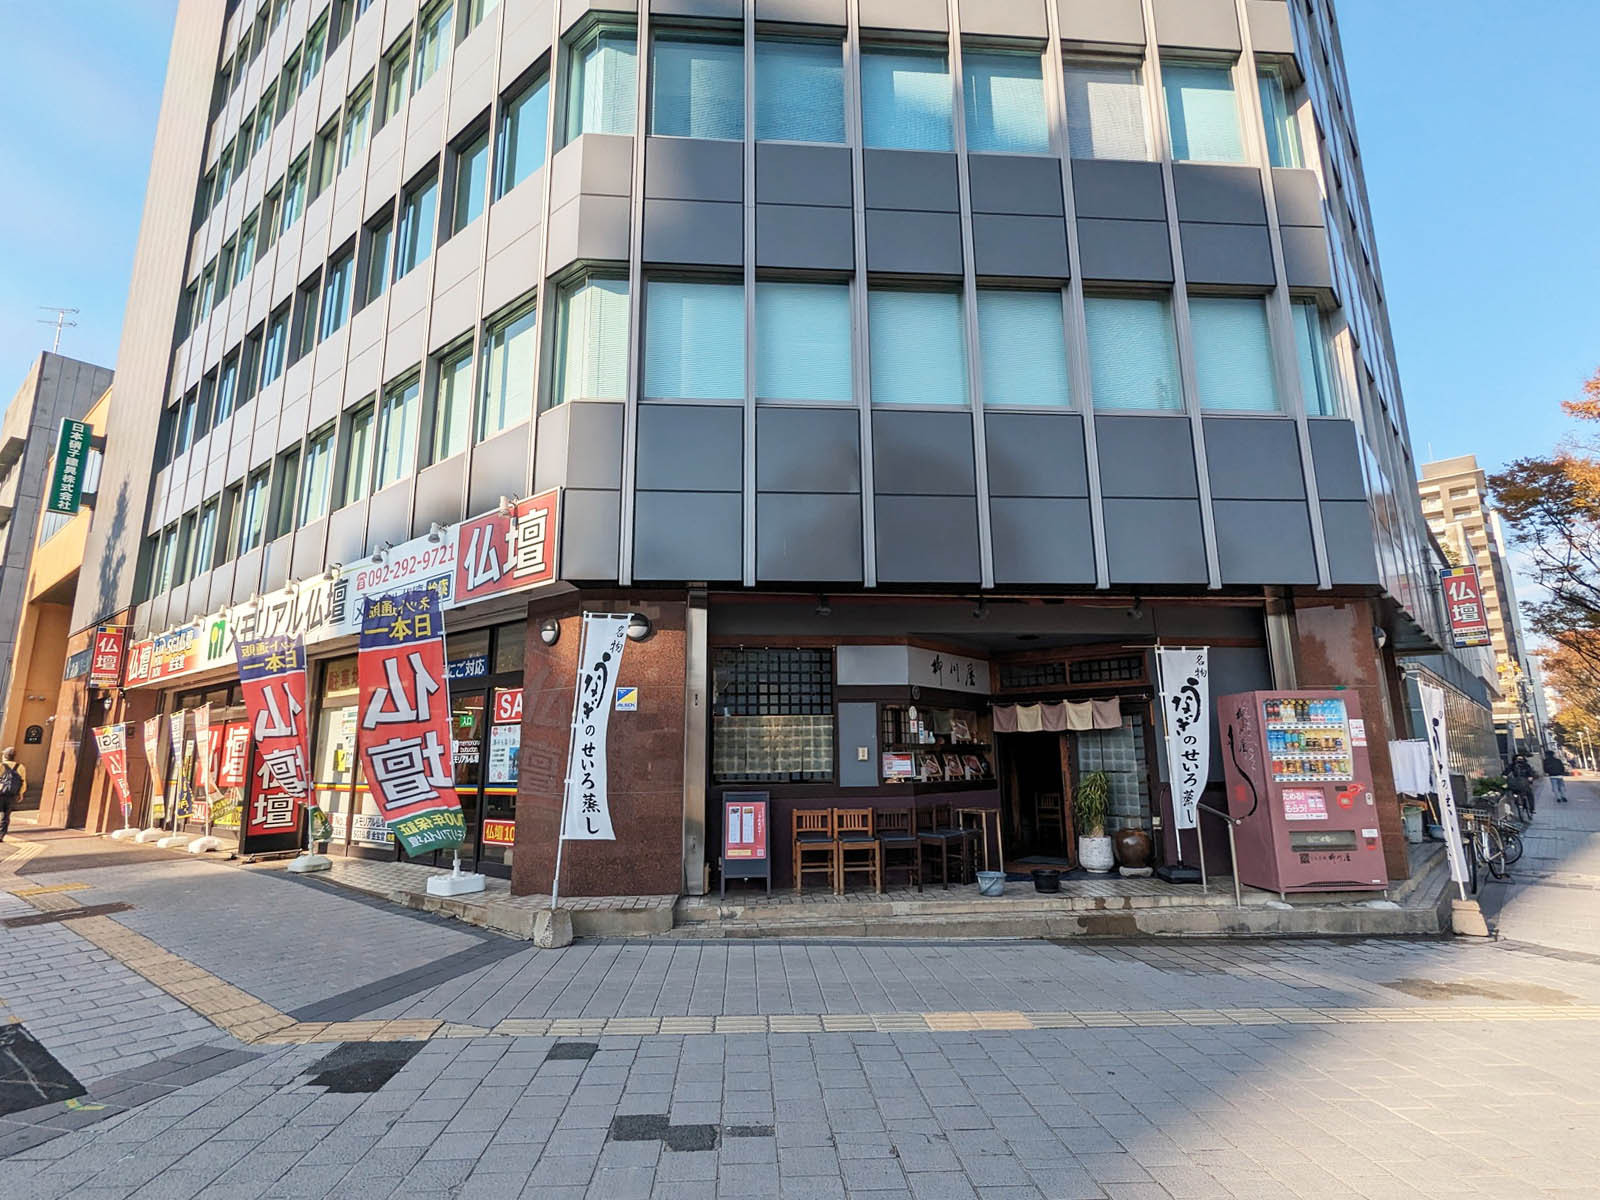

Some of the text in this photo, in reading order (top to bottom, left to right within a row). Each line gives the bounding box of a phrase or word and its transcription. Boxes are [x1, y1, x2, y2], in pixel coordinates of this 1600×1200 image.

[368, 542, 455, 588] 092-292-9721
[463, 508, 549, 592] 仏壇
[226, 579, 349, 654] メモリアル仏壇
[1449, 582, 1480, 623] 仏壇
[96, 637, 119, 671] 仏壇
[610, 624, 625, 654] 名物
[127, 645, 153, 682] 仏壇
[1194, 654, 1207, 678] 名物
